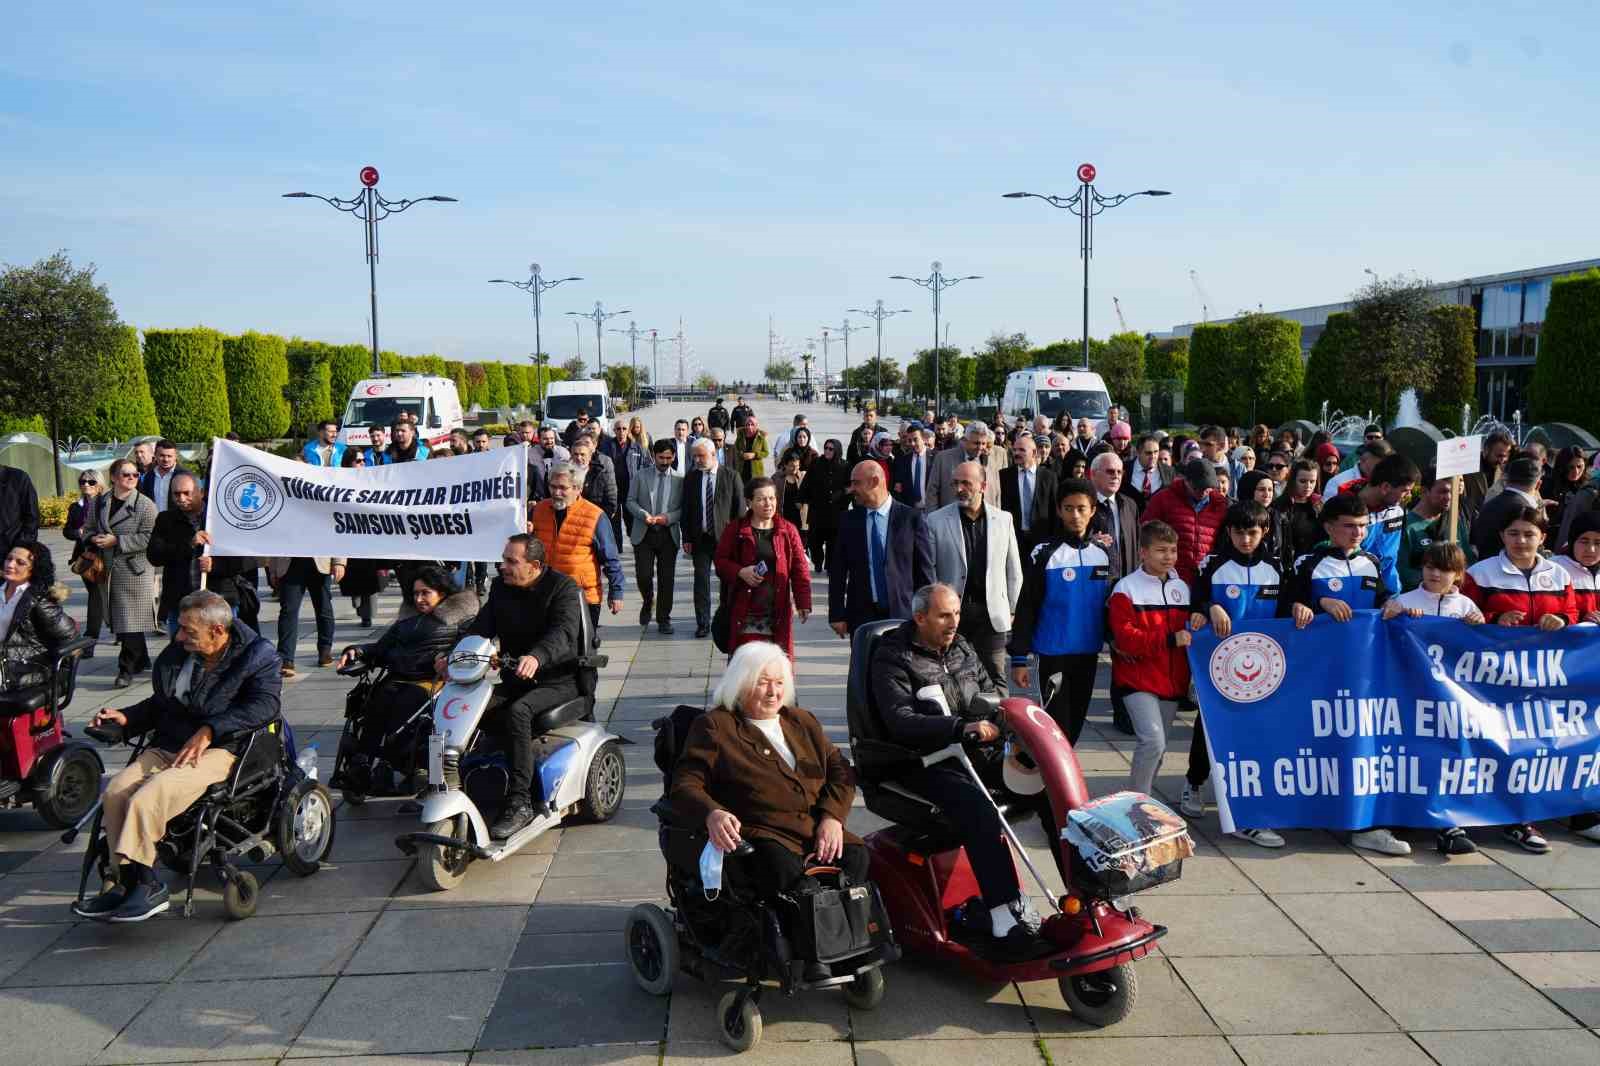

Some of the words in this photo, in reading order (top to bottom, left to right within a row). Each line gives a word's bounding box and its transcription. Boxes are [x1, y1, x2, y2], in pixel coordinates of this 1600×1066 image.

[281, 476, 355, 503] TÜRKİYE
[356, 486, 447, 506] SAKATLAR
[449, 471, 521, 505] DERNEĞİ
[333, 512, 407, 536] SAMSUN
[406, 508, 473, 540] ŞUBESİ
[1427, 644, 1446, 682] 3
[1454, 649, 1568, 687] ARALIK
[1311, 689, 1403, 737] DÜNYA
[1273, 748, 1340, 797] GÜN
[1352, 745, 1428, 796] DEĞİL
[1439, 757, 1498, 796] HER
[1507, 748, 1568, 795] GÜN
